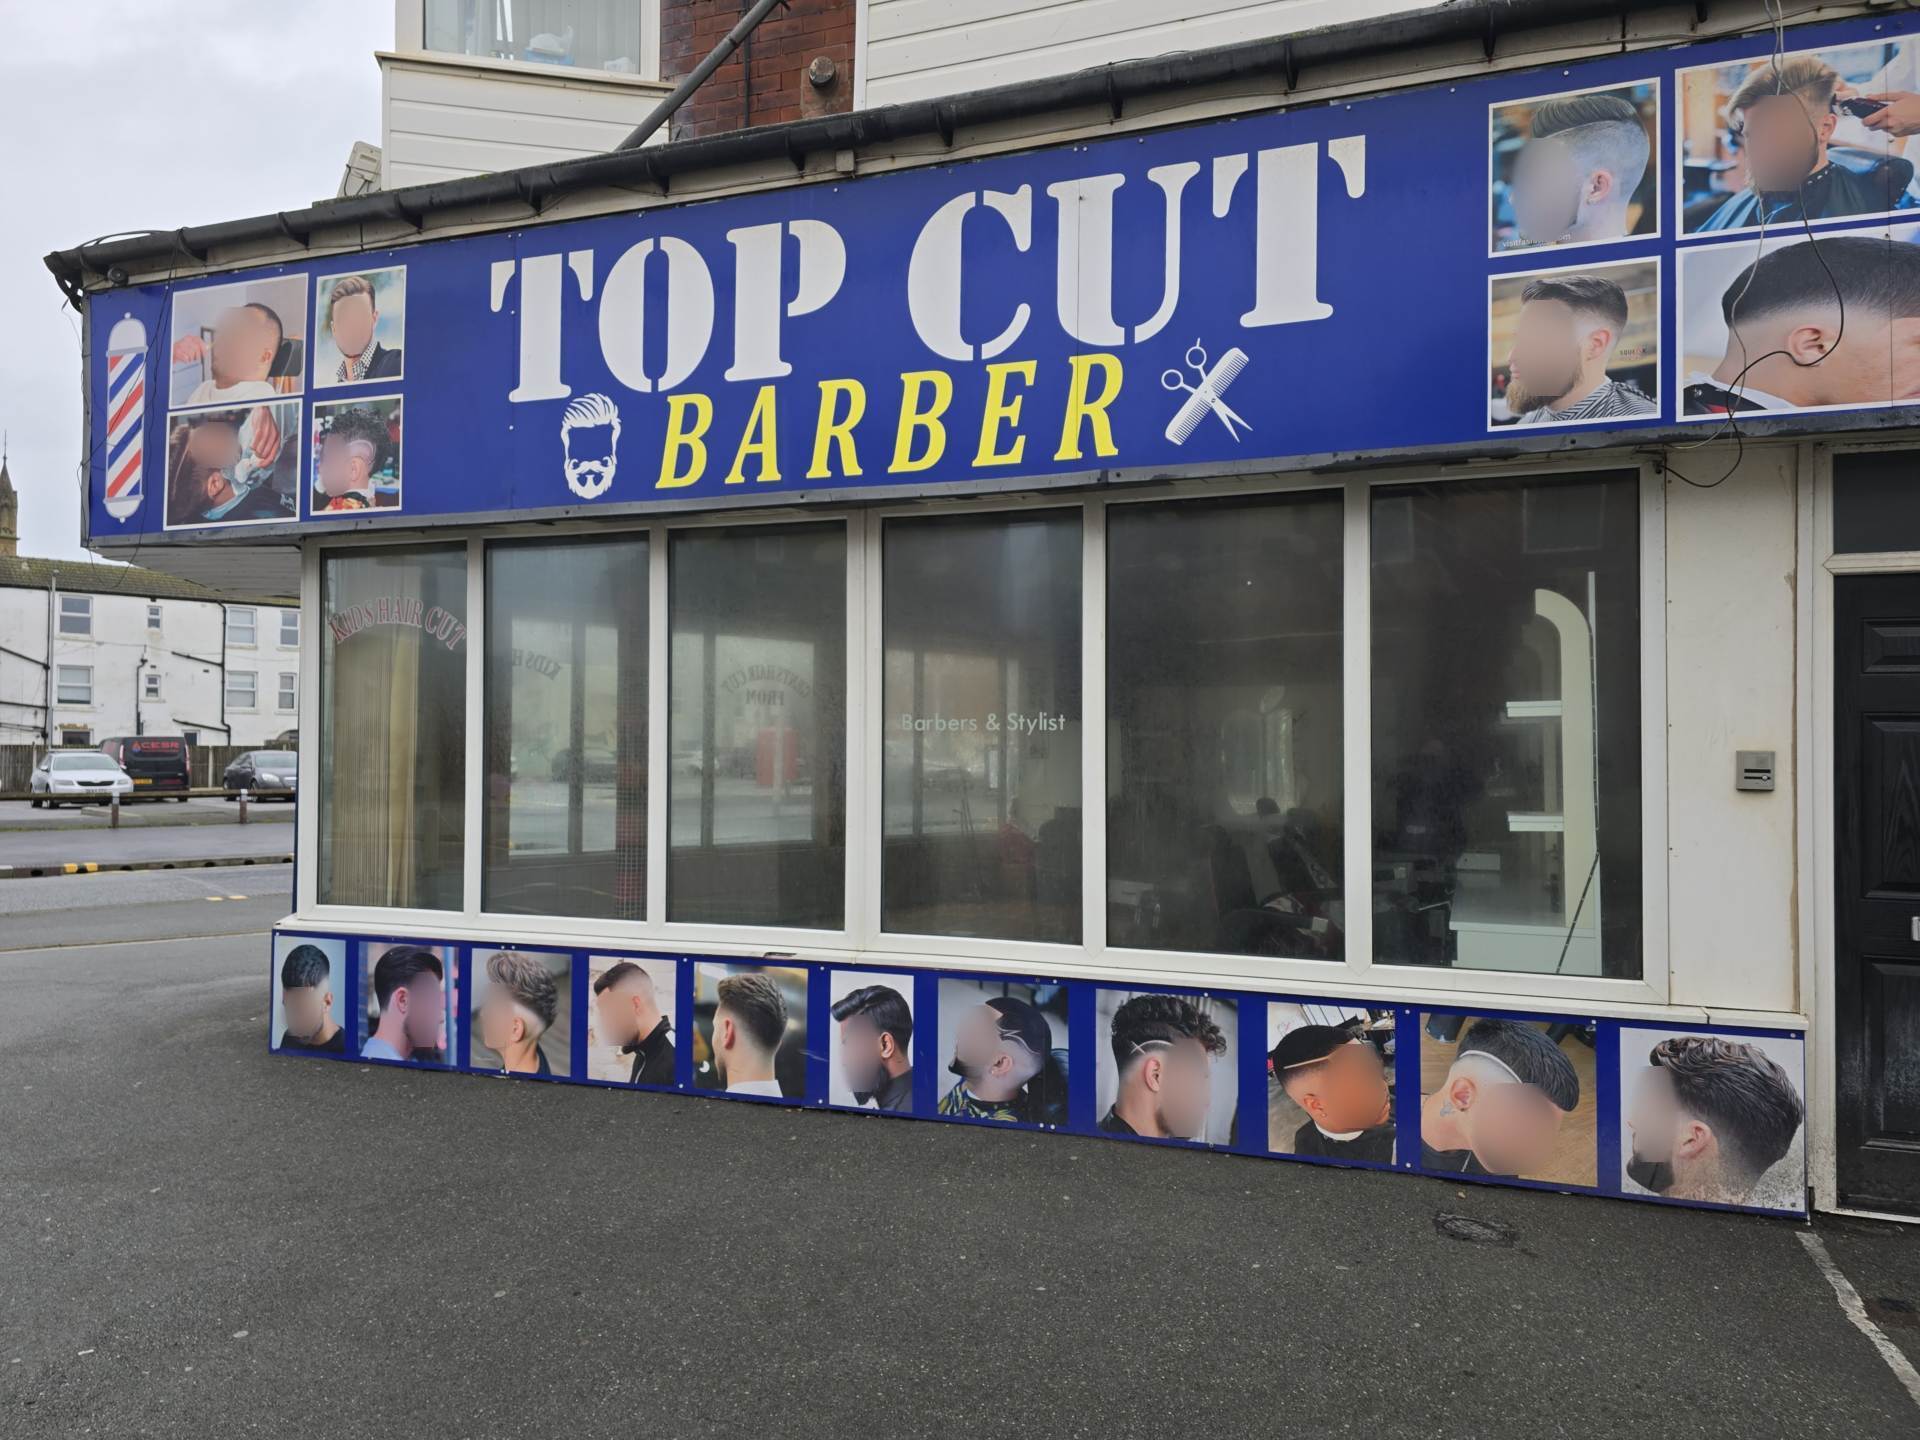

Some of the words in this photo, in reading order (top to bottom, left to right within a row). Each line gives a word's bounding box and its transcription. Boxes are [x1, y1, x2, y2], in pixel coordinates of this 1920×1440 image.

[489, 219, 847, 403] TOP
[907, 134, 1367, 362] CUT
[655, 353, 1125, 490] BARBER
[328, 602, 375, 645] KIDS
[376, 596, 424, 628] HAIR
[425, 606, 467, 650] CUT
[901, 713, 977, 732] Barbers
[985, 713, 1001, 731] &
[1007, 711, 1066, 735] Stylist
